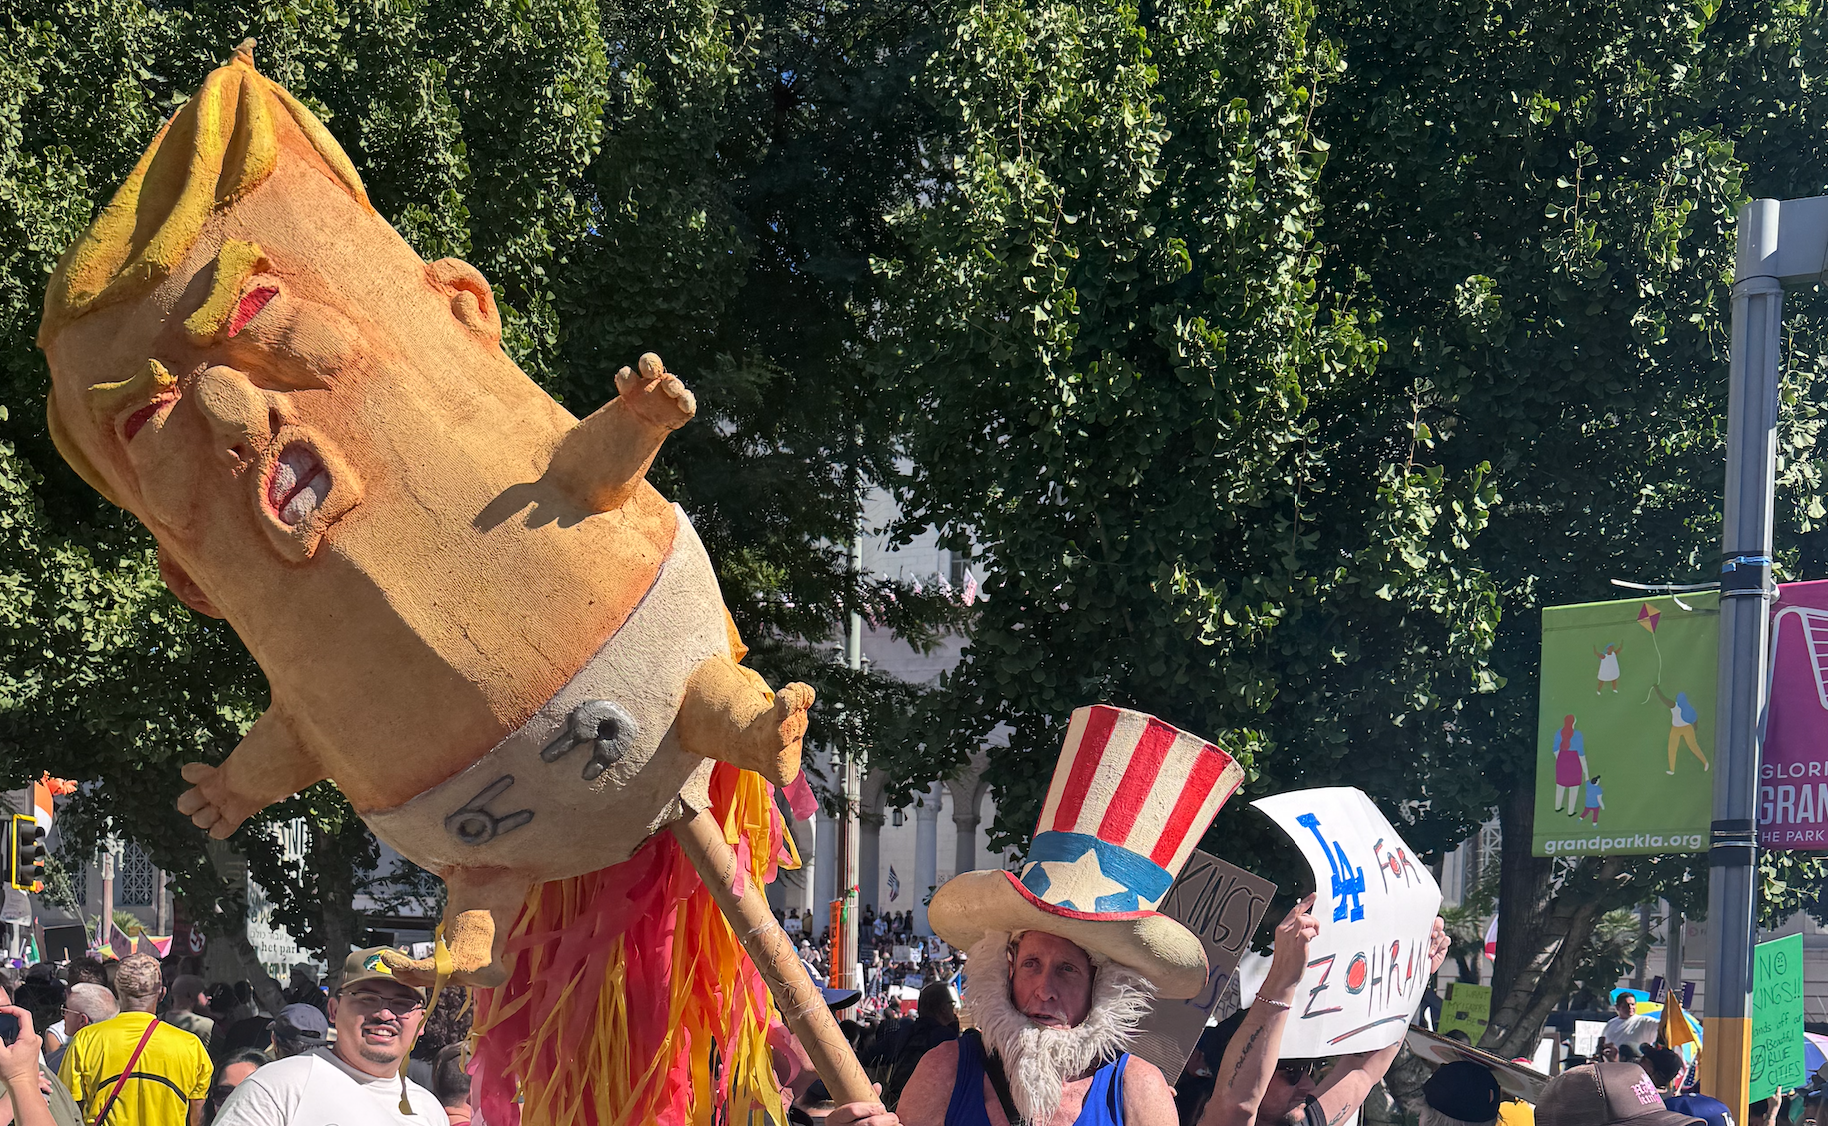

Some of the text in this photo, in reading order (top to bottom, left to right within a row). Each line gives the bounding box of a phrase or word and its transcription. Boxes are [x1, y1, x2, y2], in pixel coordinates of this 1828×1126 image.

[1544, 834, 1702, 855] grandparkla.org
[1761, 830, 1825, 842] HE PARK
[1373, 838, 1421, 894] FOR
[1163, 853, 1266, 957] KINGS
[1300, 939, 1431, 1019] ZOHRAN
[1753, 1021, 1772, 1038] ands
[1768, 1045, 1792, 1067] BLUE
[1768, 1060, 1801, 1085] CITIES
